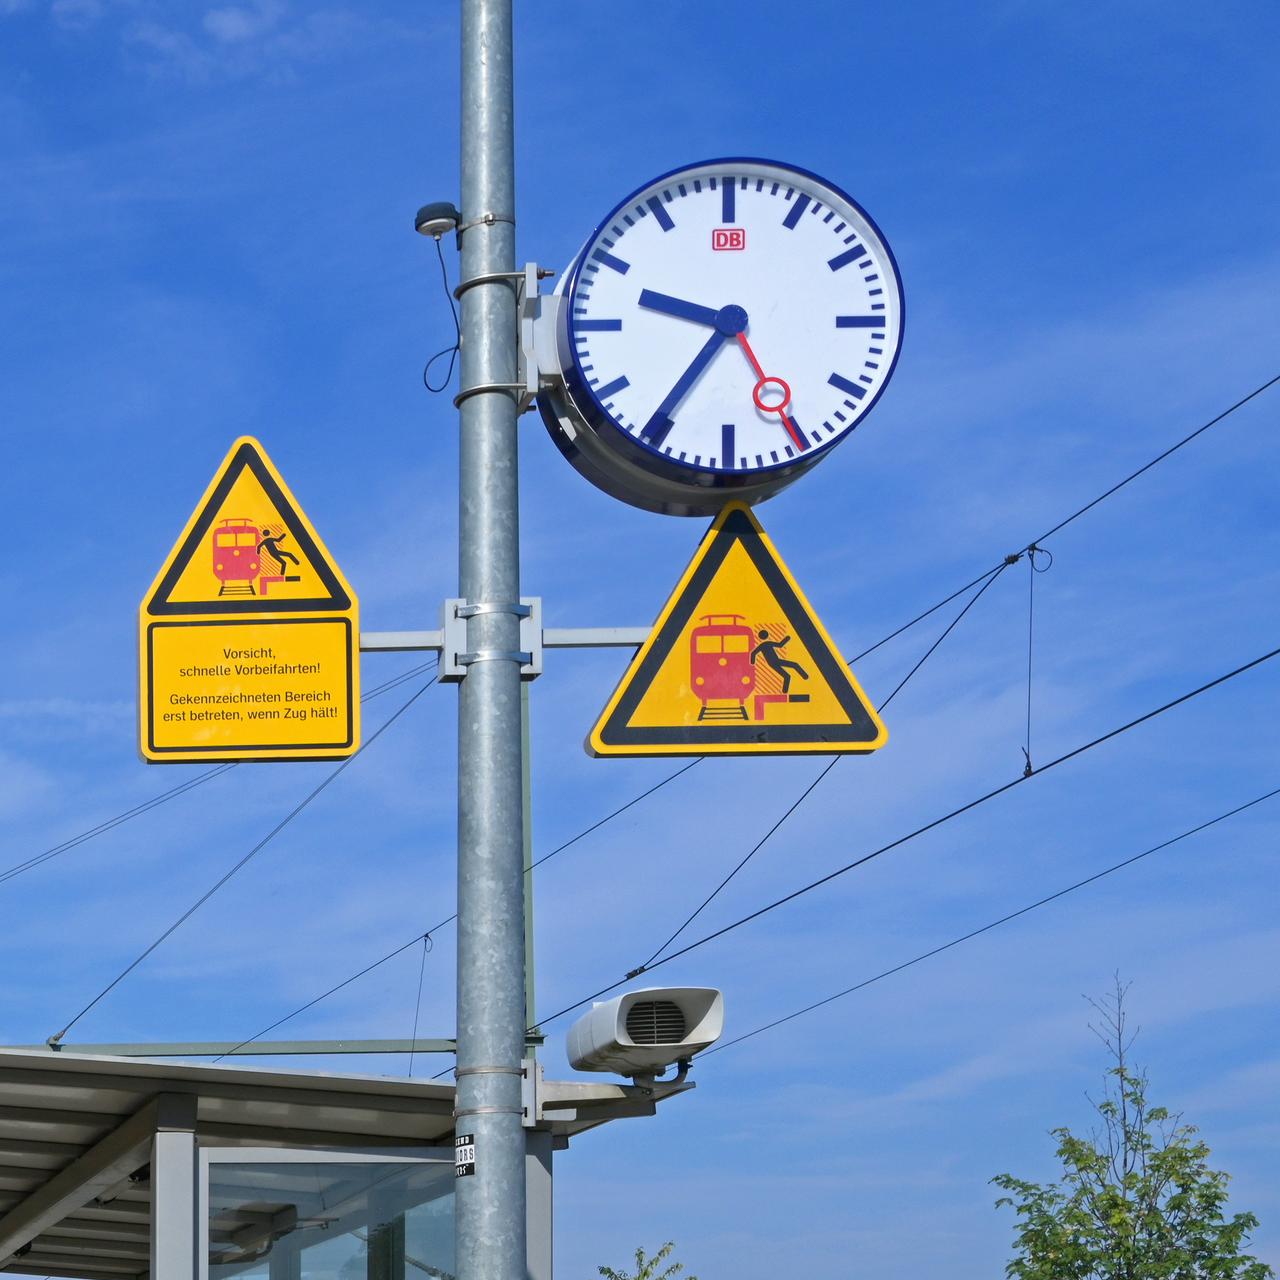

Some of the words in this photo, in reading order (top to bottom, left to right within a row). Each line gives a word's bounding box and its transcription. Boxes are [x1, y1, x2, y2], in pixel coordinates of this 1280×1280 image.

[717, 233, 741, 247] DB
[223, 648, 276, 660] Vorsicht,
[179, 665, 231, 677] schnelle
[235, 663, 320, 676] Vorbeifahrten!
[170, 693, 281, 705] Gekennzeichneten
[285, 691, 331, 702] Bereich
[163, 711, 186, 722] erst
[190, 710, 244, 722] betreten,
[248, 711, 280, 719] wenn
[284, 708, 307, 721] Zug
[311, 707, 338, 718] hält!
